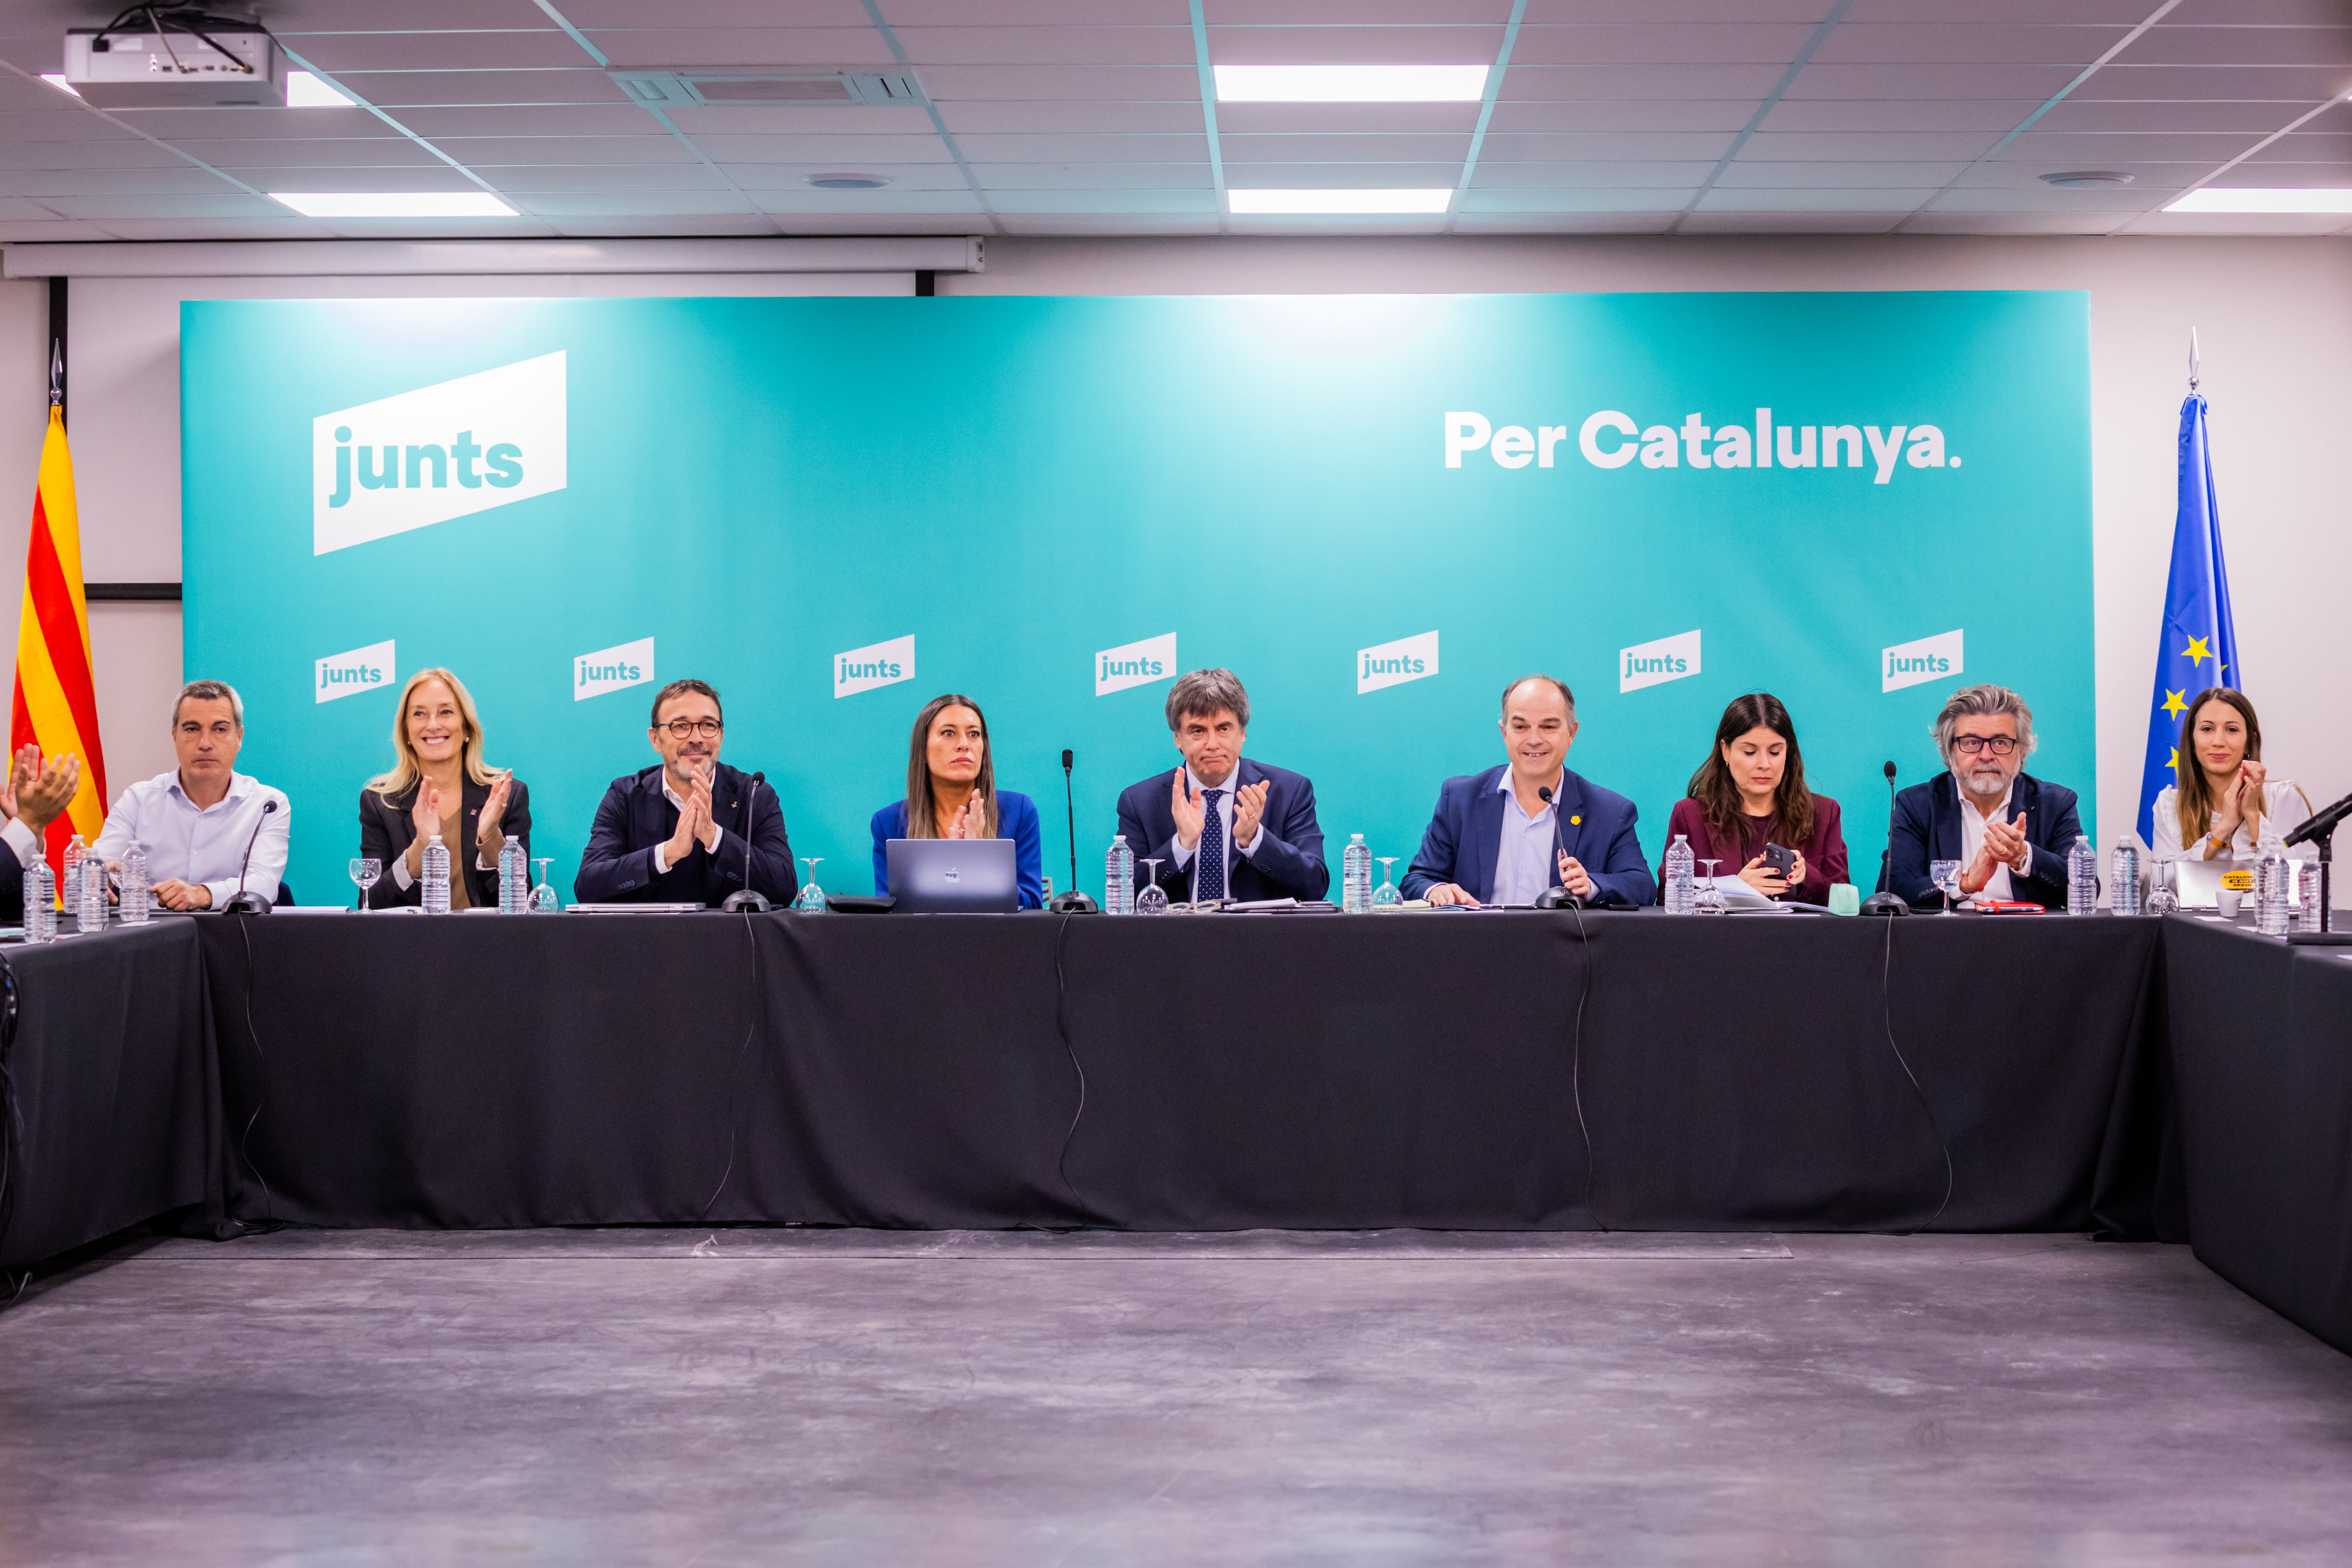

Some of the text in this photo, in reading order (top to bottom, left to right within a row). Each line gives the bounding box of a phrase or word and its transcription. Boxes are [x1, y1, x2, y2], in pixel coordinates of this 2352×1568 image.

[1445, 407, 1962, 484] Per Catalunya.
[329, 425, 524, 508] junts
[321, 663, 381, 689] junts
[580, 661, 640, 686] junts
[840, 658, 901, 684] junts
[1101, 655, 1162, 681] junts
[1363, 653, 1424, 679] junts
[1625, 653, 1687, 678] junts
[1888, 652, 1949, 677] junts
